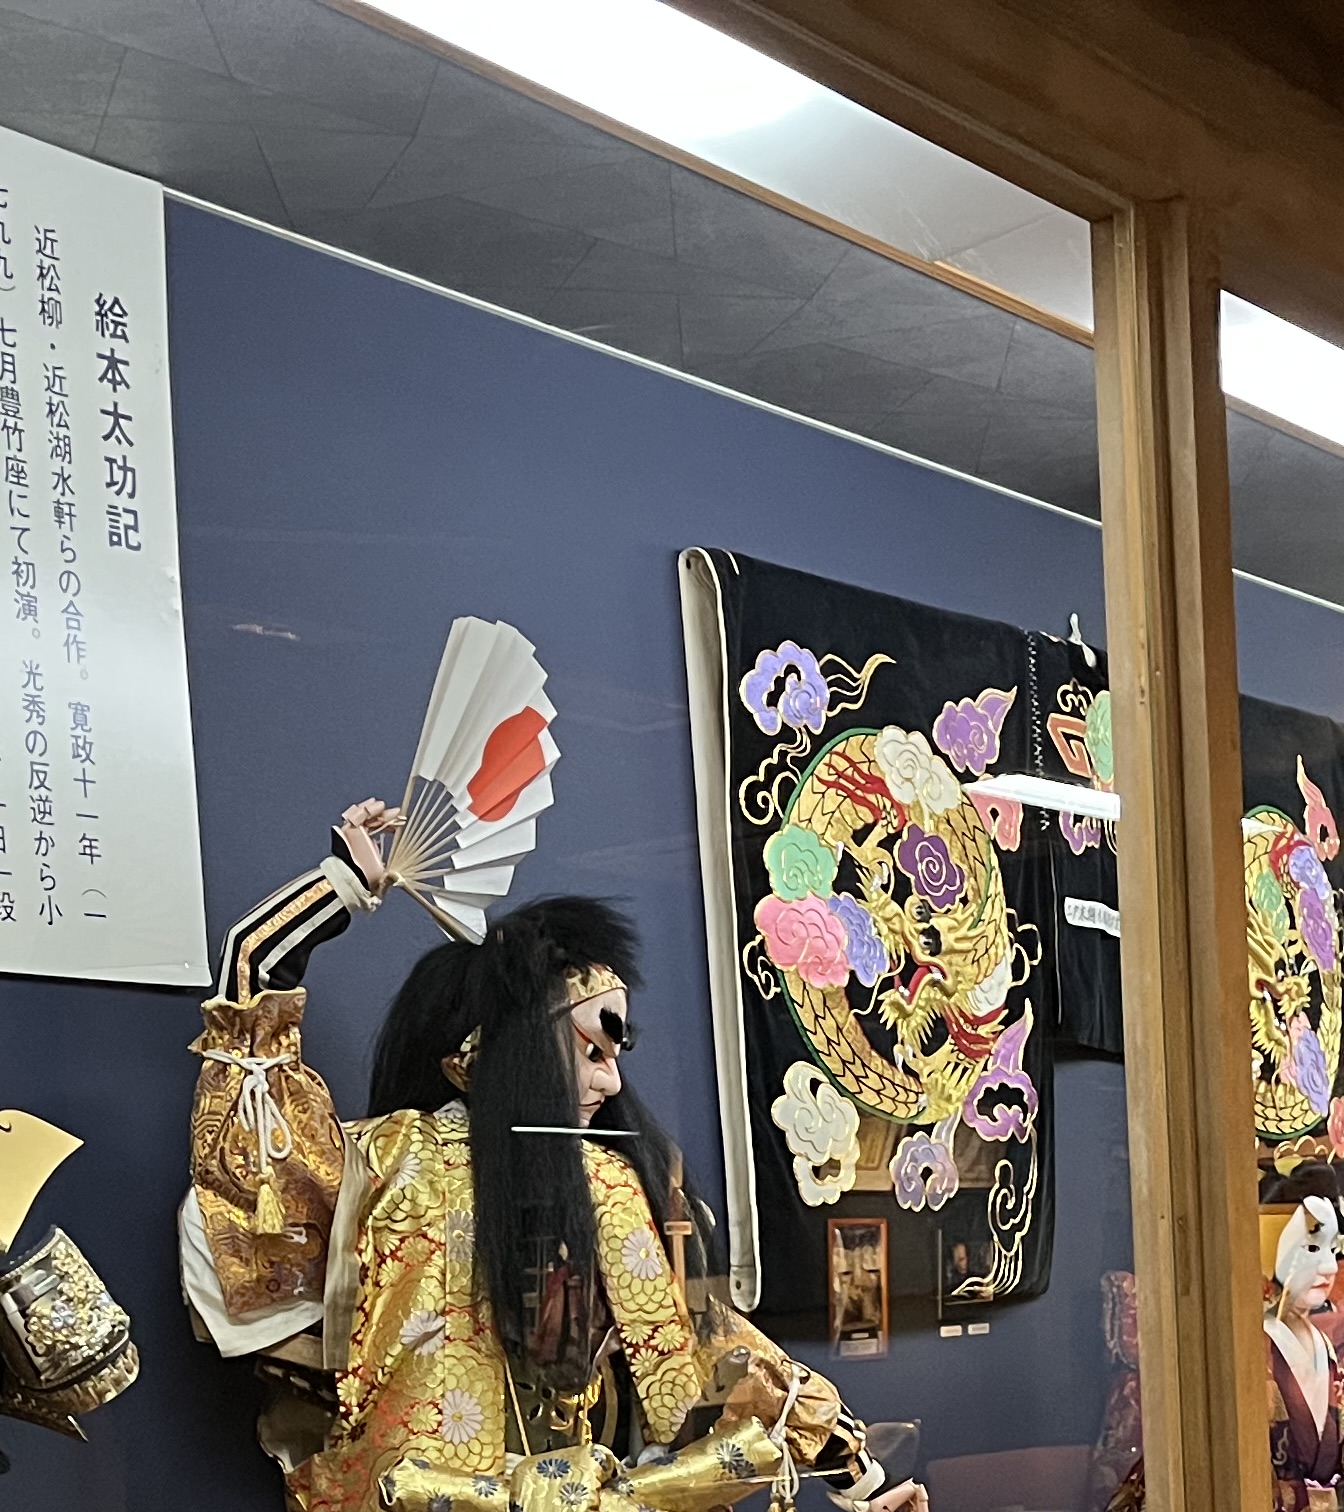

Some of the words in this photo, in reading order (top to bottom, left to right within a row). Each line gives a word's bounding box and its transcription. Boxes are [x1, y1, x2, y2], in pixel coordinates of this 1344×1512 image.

[94, 292, 142, 551] 絵本太功記
